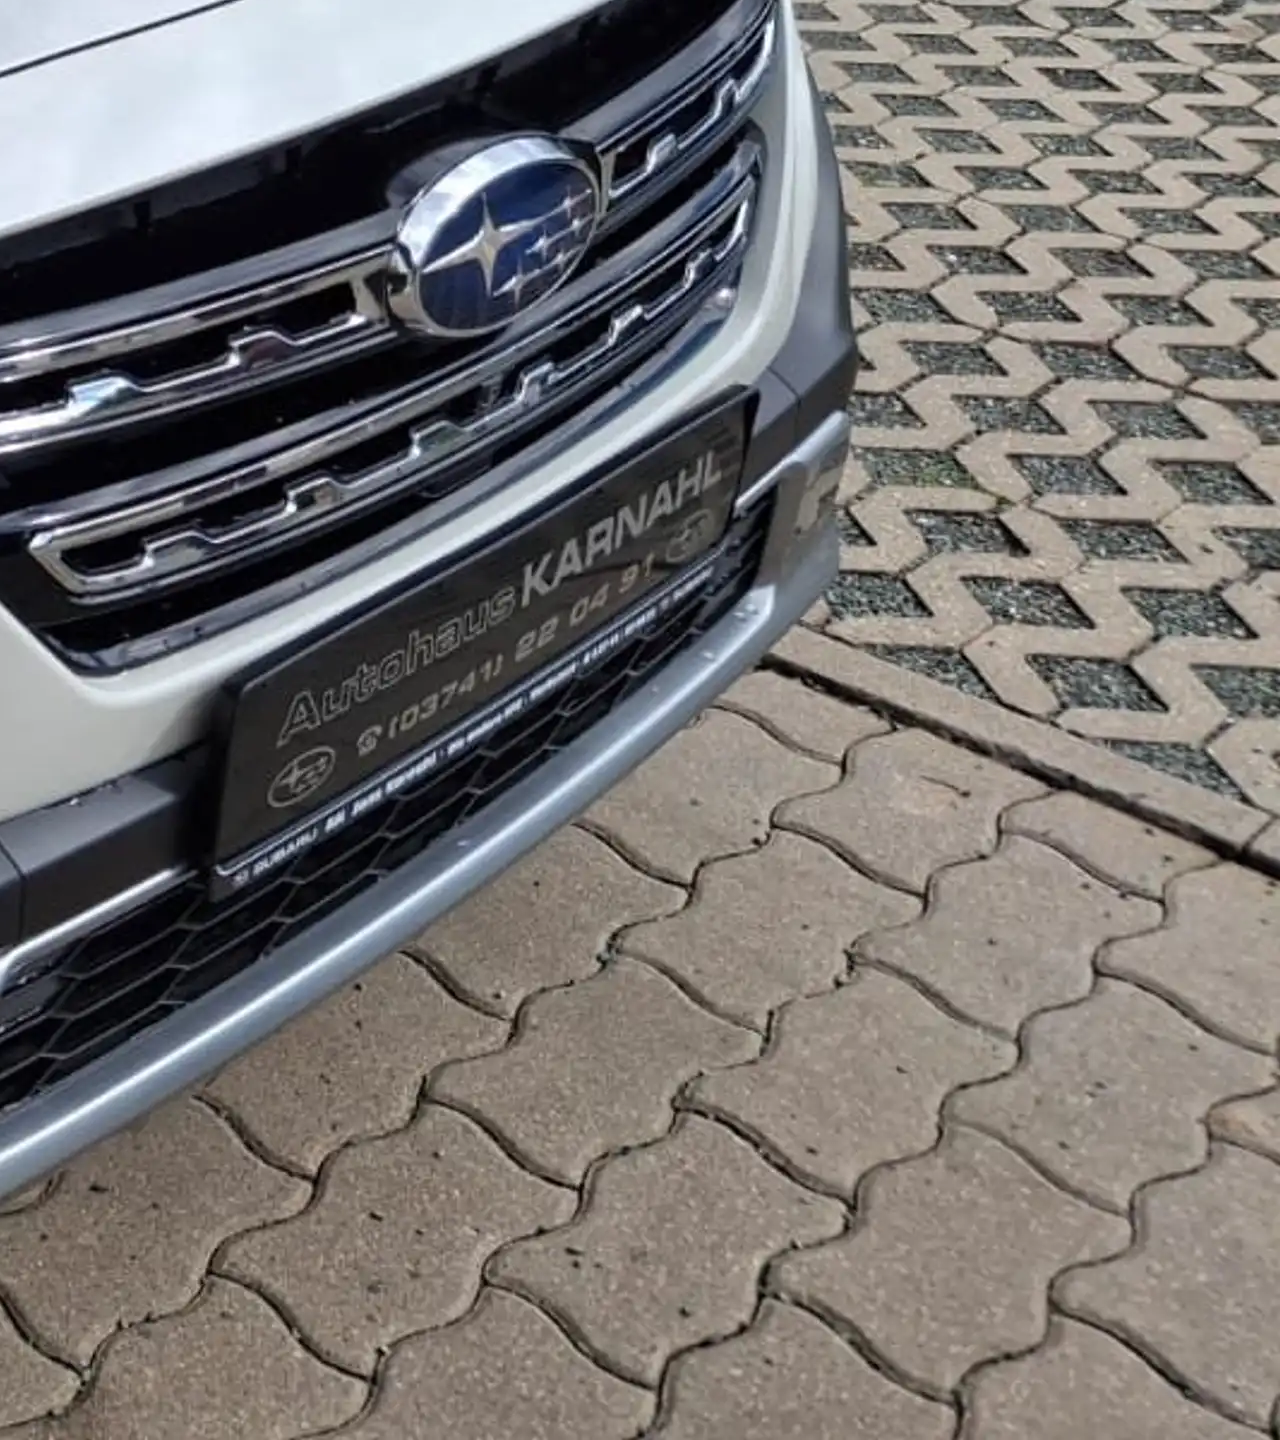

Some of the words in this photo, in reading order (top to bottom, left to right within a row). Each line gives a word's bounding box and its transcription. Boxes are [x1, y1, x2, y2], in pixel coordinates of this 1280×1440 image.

[276, 585, 516, 747] Autohaus
[520, 450, 723, 608] KARNAHL
[514, 621, 559, 662] 22
[568, 587, 609, 625] 04
[617, 551, 655, 596] 91
